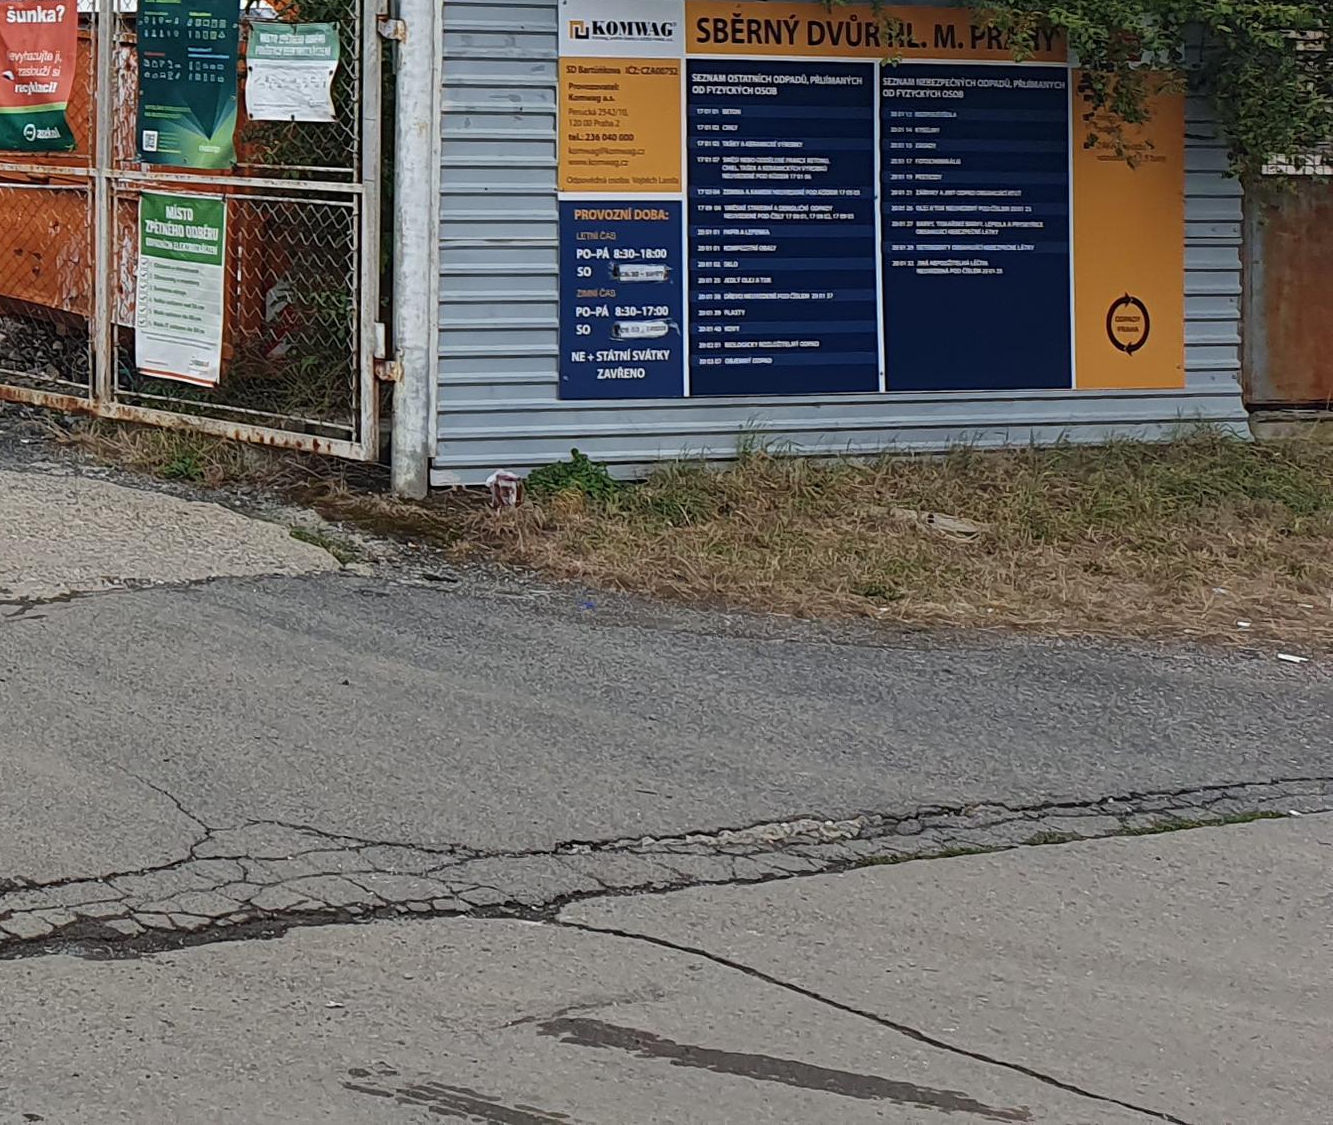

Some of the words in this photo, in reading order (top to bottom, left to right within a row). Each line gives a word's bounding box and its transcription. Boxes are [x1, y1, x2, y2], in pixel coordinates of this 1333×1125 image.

[6, 5, 66, 23] šunka?
[591, 19, 674, 38] KOMWAG
[696, 13, 800, 46] SBĚRNÝ
[807, 14, 881, 48] DVŮR
[934, 24, 964, 49] M.
[566, 65, 577, 74] SD
[691, 73, 726, 83] SEZNAM
[691, 86, 706, 95] OD
[882, 90, 895, 98] OD
[602, 133, 617, 141] 040
[165, 204, 194, 221] MÍSTO
[574, 208, 632, 221] PROVOZNÍ
[634, 209, 670, 221] DOBA:
[576, 266, 592, 278] SO
[576, 324, 591, 335] SO
[571, 351, 586, 362] NE
[596, 348, 632, 362] STÁTNÍ
[632, 348, 671, 362] SVÁTKY
[596, 367, 646, 380] ZAVŘENO
